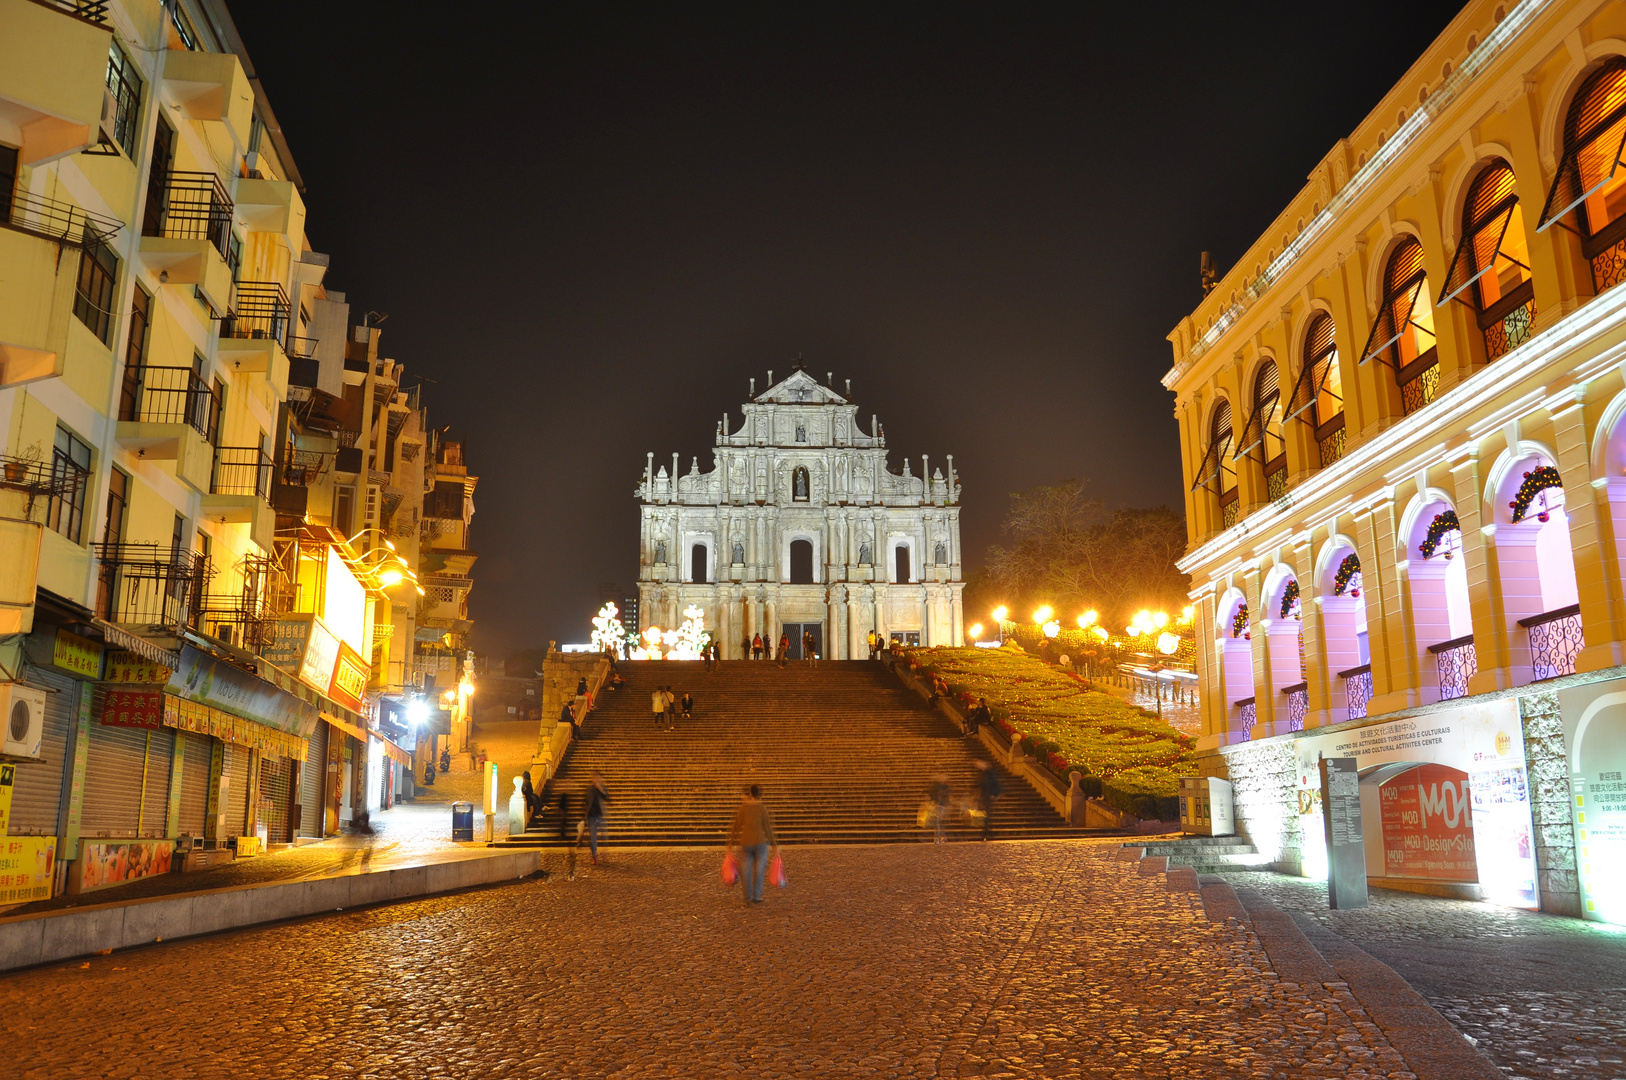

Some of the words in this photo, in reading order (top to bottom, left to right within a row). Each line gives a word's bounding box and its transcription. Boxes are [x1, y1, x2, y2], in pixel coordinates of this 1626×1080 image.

[1360, 721, 1417, 739] 旅遊文化活動中心
[1336, 743, 1352, 751] CENTRO
[1359, 738, 1387, 748] ACTIVIDADES
[1388, 731, 1416, 742] TURÍSTICAS
[1421, 727, 1451, 737] CULTURAIS
[1343, 750, 1361, 758] TOURISM
[1371, 744, 1395, 754] CULTURAL
[1422, 737, 1443, 746] CENTER
[1382, 786, 1398, 800] MOD
[1402, 810, 1419, 824] MOD
[1404, 835, 1420, 849] MOD
[1387, 849, 1404, 863] MOD
